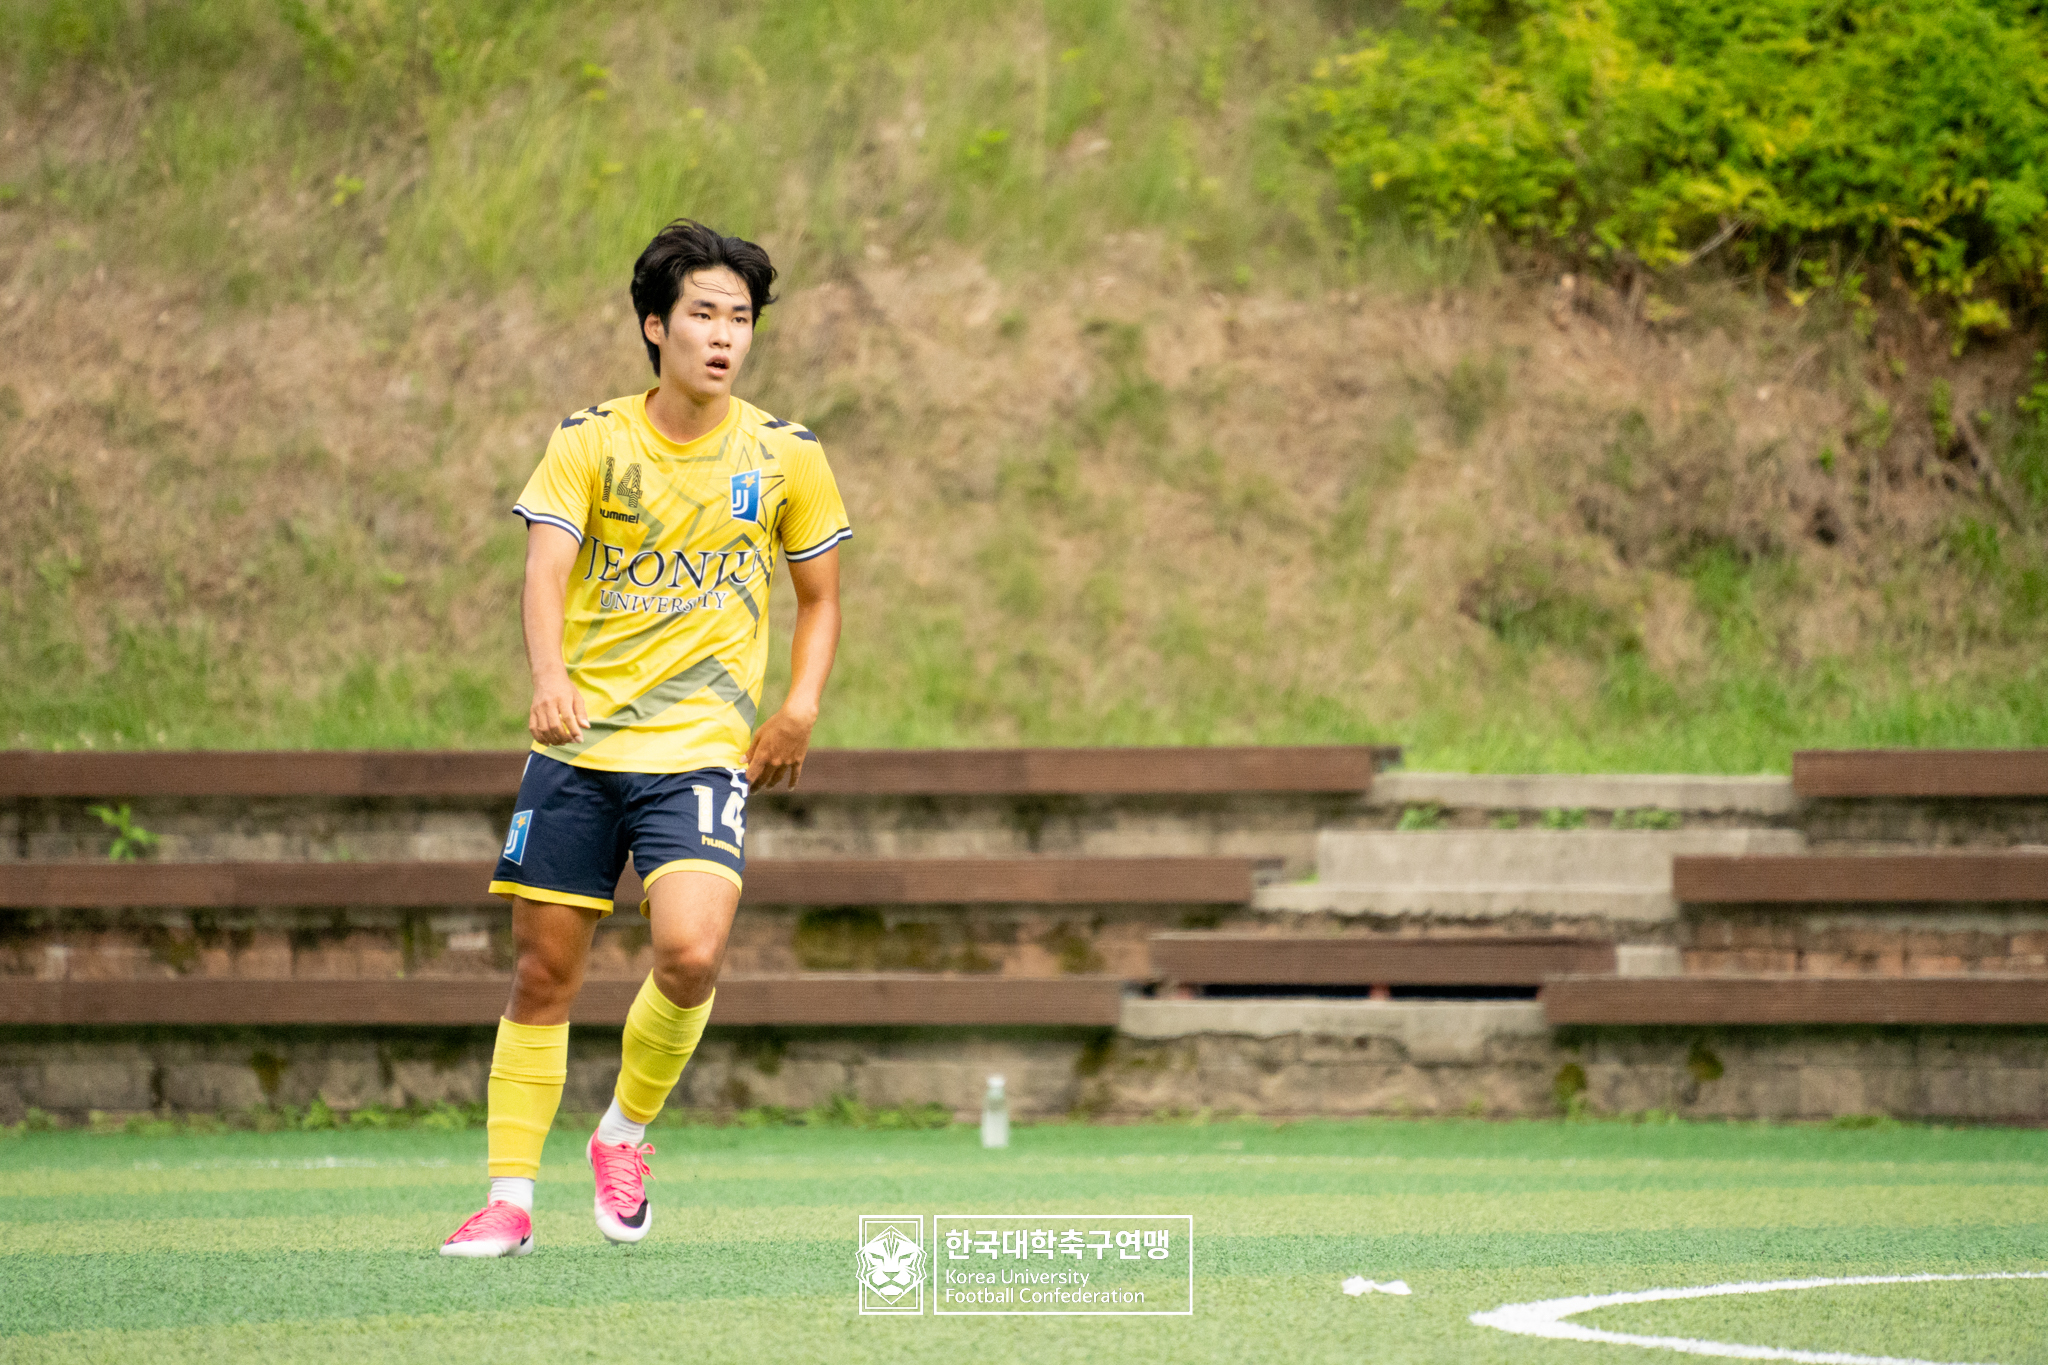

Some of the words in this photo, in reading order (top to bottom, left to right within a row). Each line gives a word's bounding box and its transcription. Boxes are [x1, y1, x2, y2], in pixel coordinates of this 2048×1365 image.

[601, 455, 643, 508] 14
[584, 535, 761, 591] JEONJU
[691, 784, 746, 848] 14
